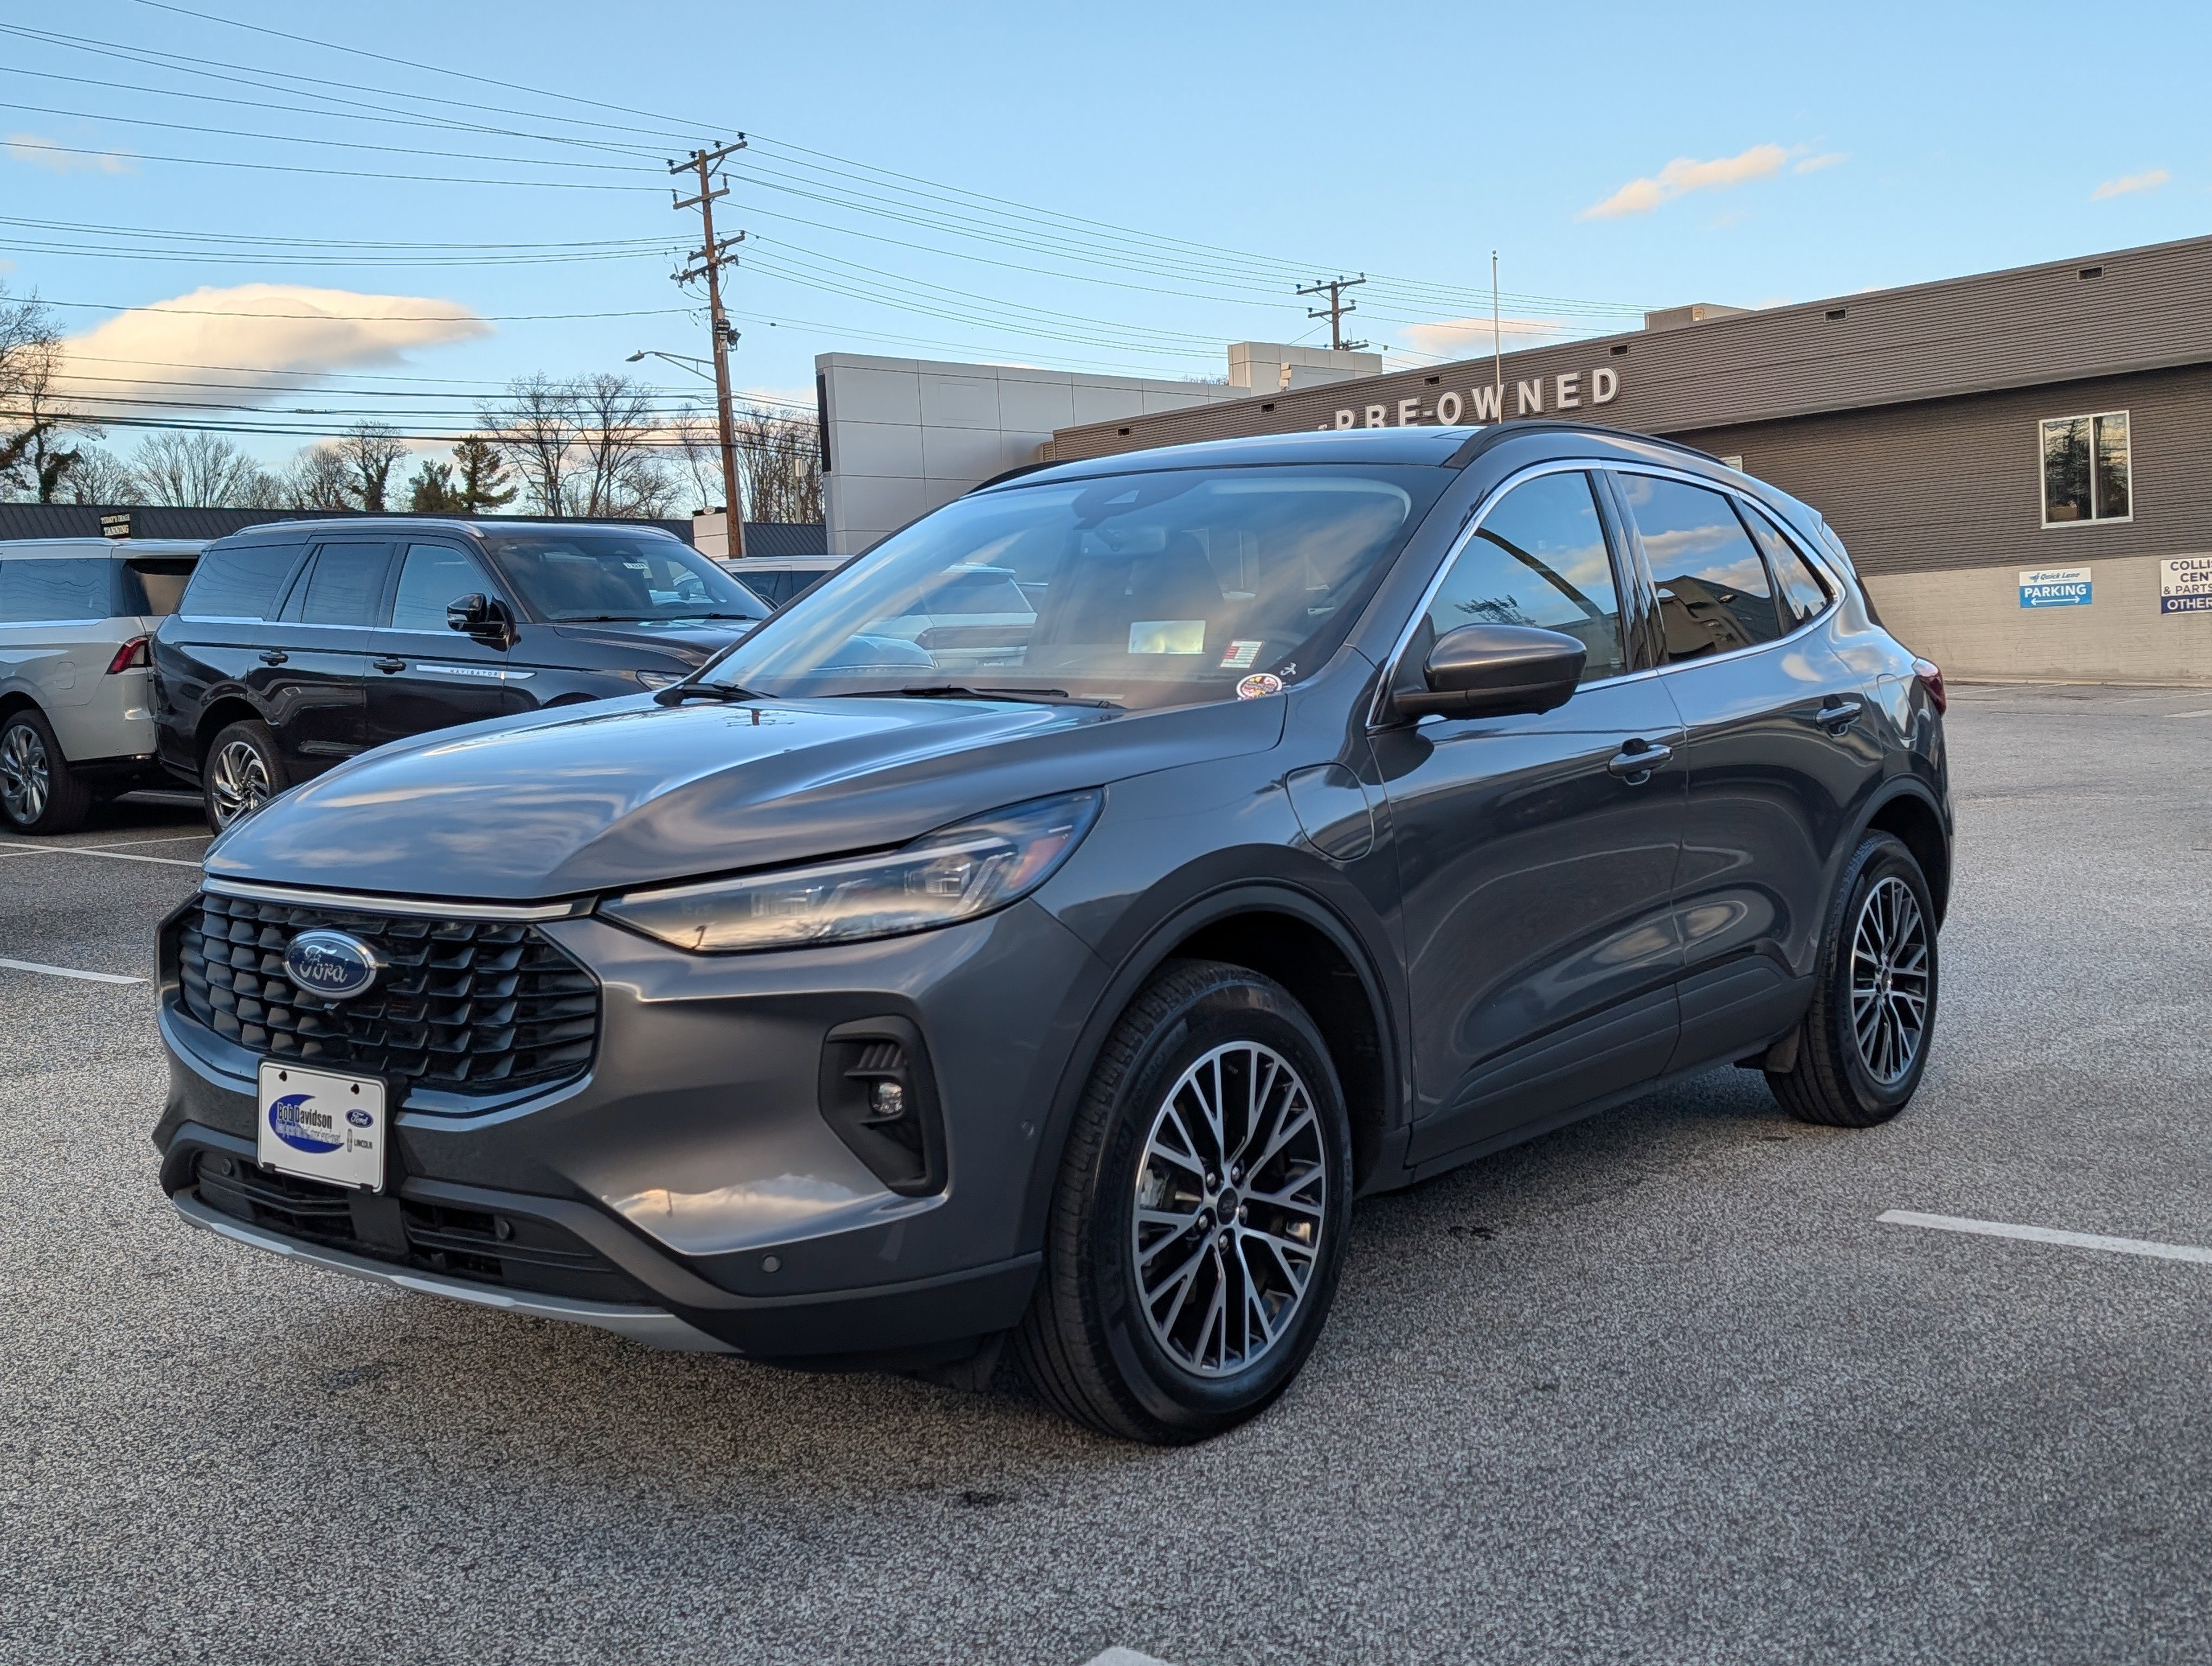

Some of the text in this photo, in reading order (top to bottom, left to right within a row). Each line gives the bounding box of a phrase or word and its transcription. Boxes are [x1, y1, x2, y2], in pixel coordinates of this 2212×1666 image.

[1335, 367, 1620, 430] PRE-OWNED
[2170, 559, 2212, 571] COLLI
[2040, 573, 2061, 581] Quick
[2024, 585, 2087, 598] PARKING
[2163, 586, 2171, 595] &
[299, 945, 348, 983] Ford
[278, 1102, 332, 1130] Bob Davidson
[351, 1112, 368, 1125] Ford
